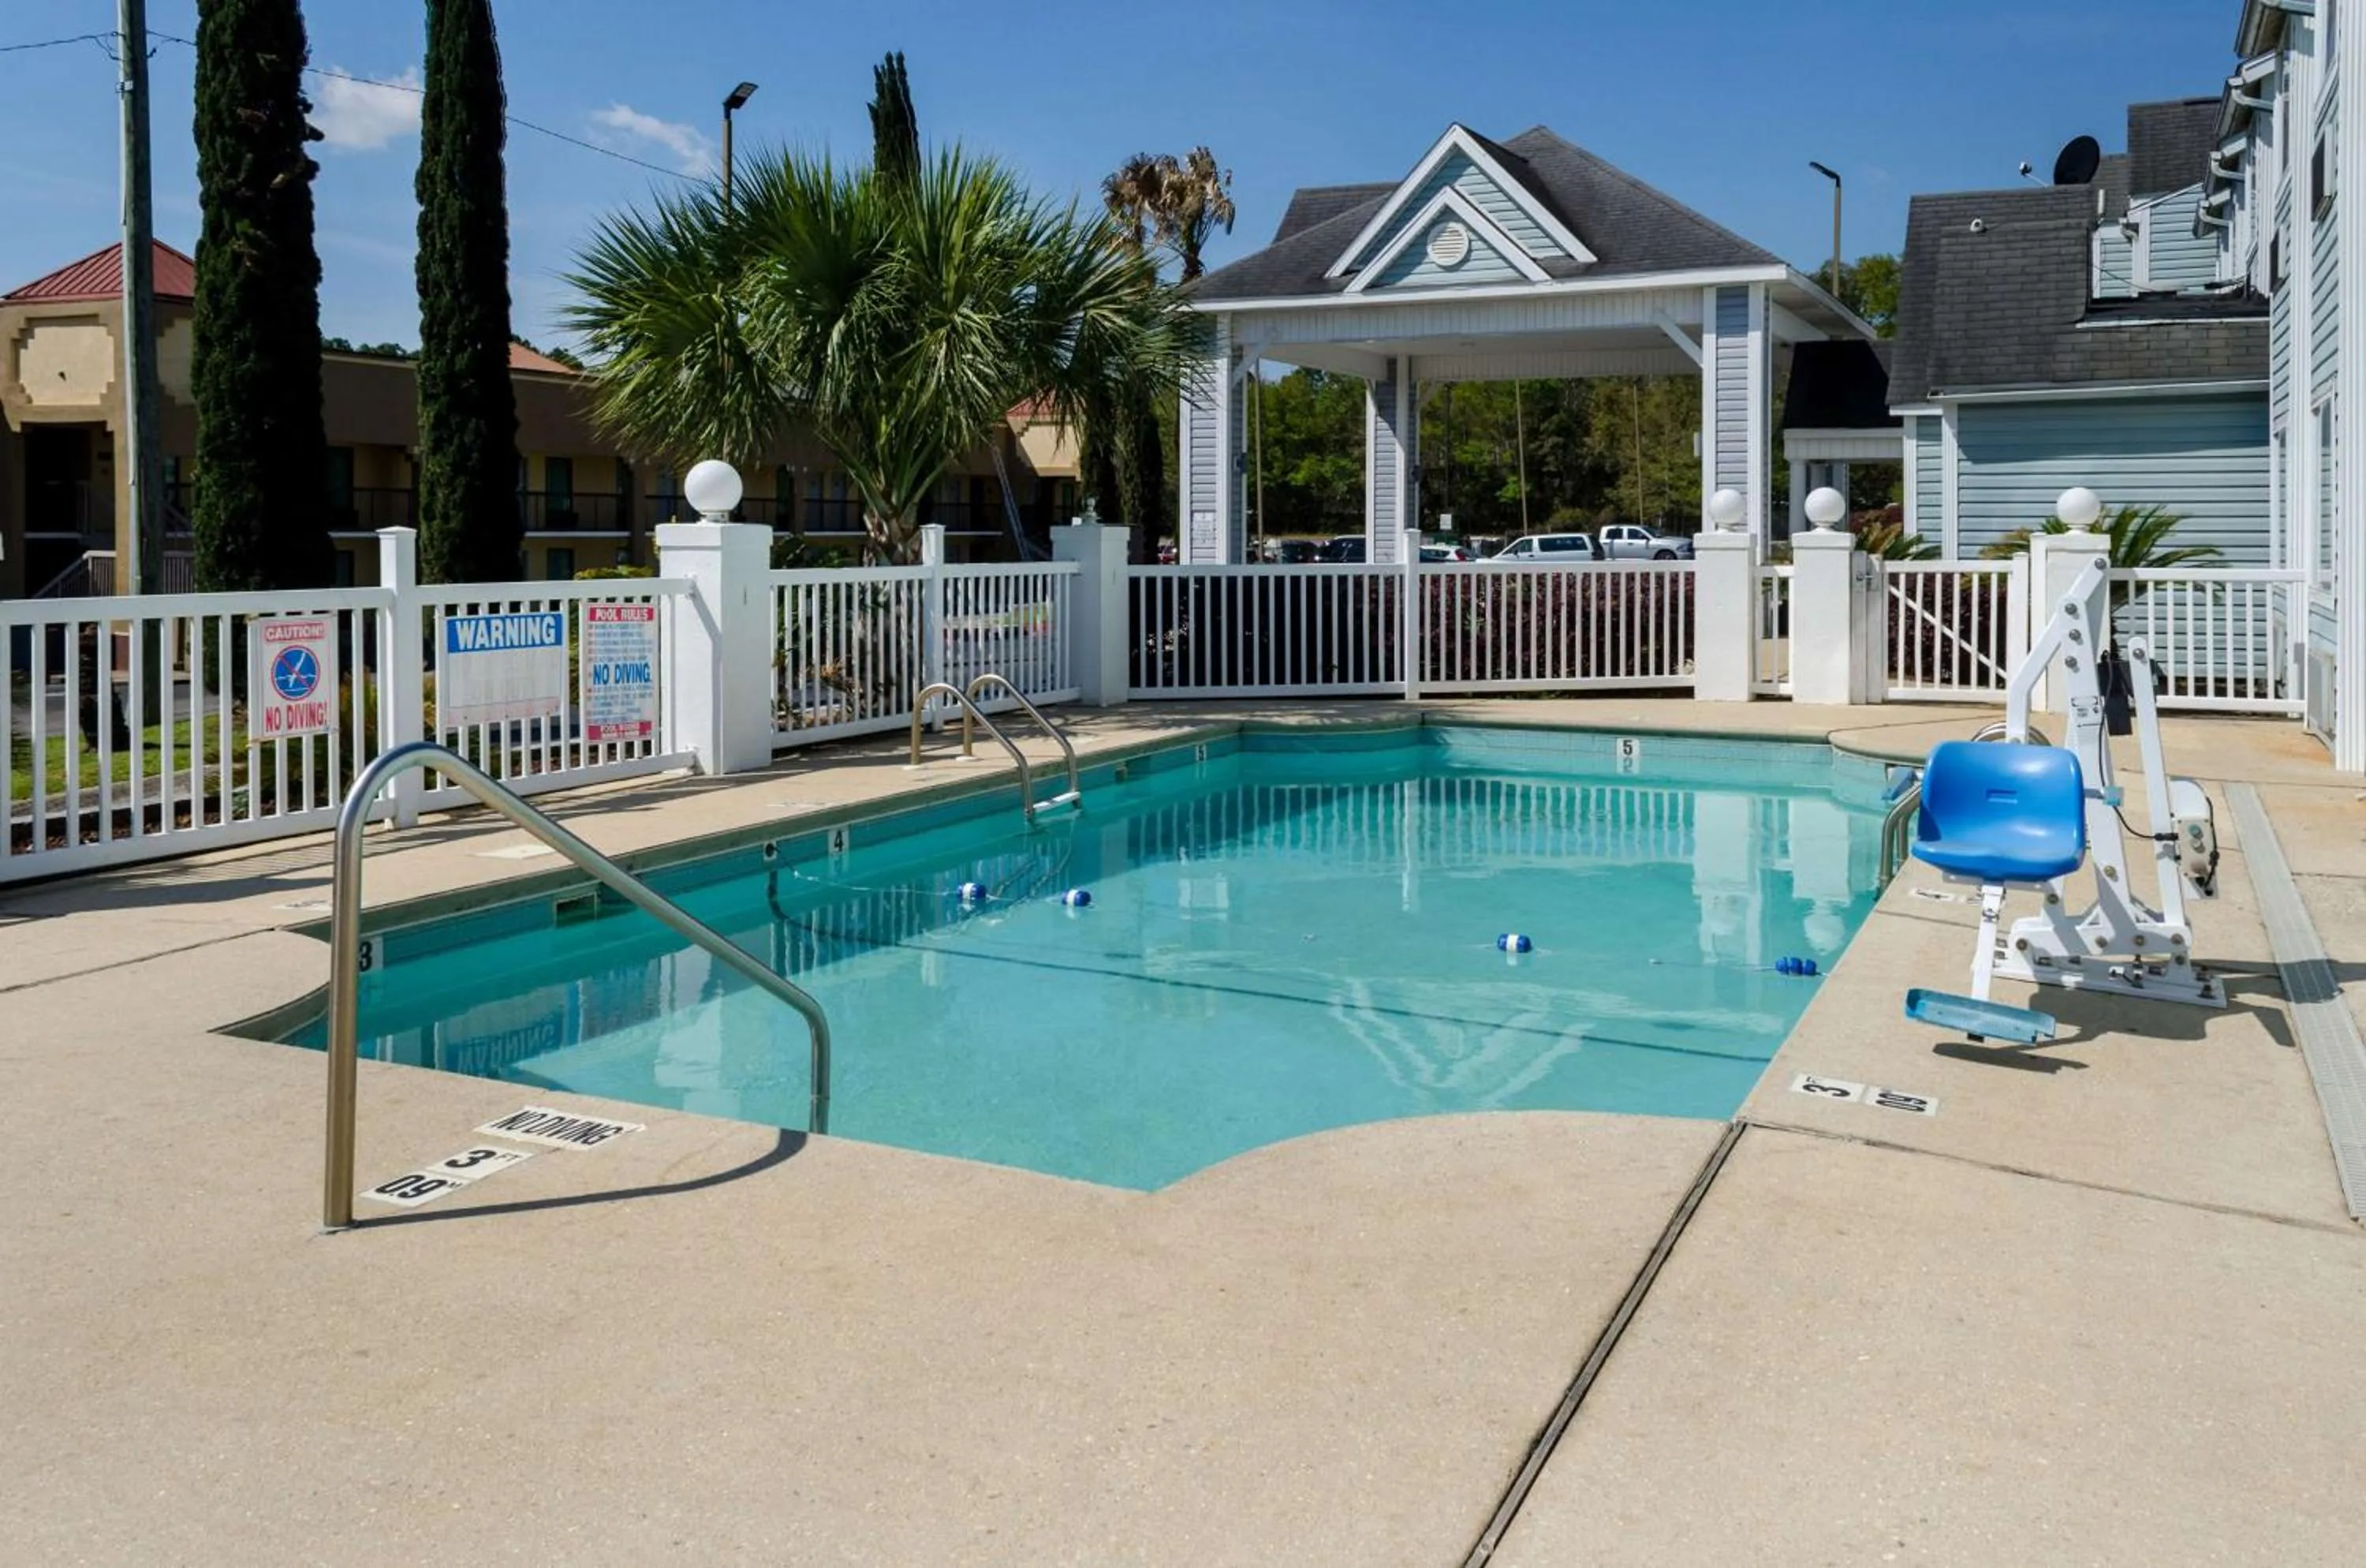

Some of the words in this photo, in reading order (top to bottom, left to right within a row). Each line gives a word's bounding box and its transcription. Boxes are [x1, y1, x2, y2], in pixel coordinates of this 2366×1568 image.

[595, 607, 618, 622] POOL
[621, 607, 649, 621] RULES
[455, 614, 556, 651] WARNING
[593, 663, 610, 685] NO
[266, 706, 282, 732] NO
[286, 701, 328, 730] DIVING!
[1622, 739, 1633, 756] 5
[834, 830, 844, 852] 4
[359, 941, 372, 973] 3
[1802, 1083, 1851, 1097] 3
[489, 1109, 548, 1131] NO
[521, 1115, 624, 1146] DIVING
[444, 1148, 497, 1169] 3
